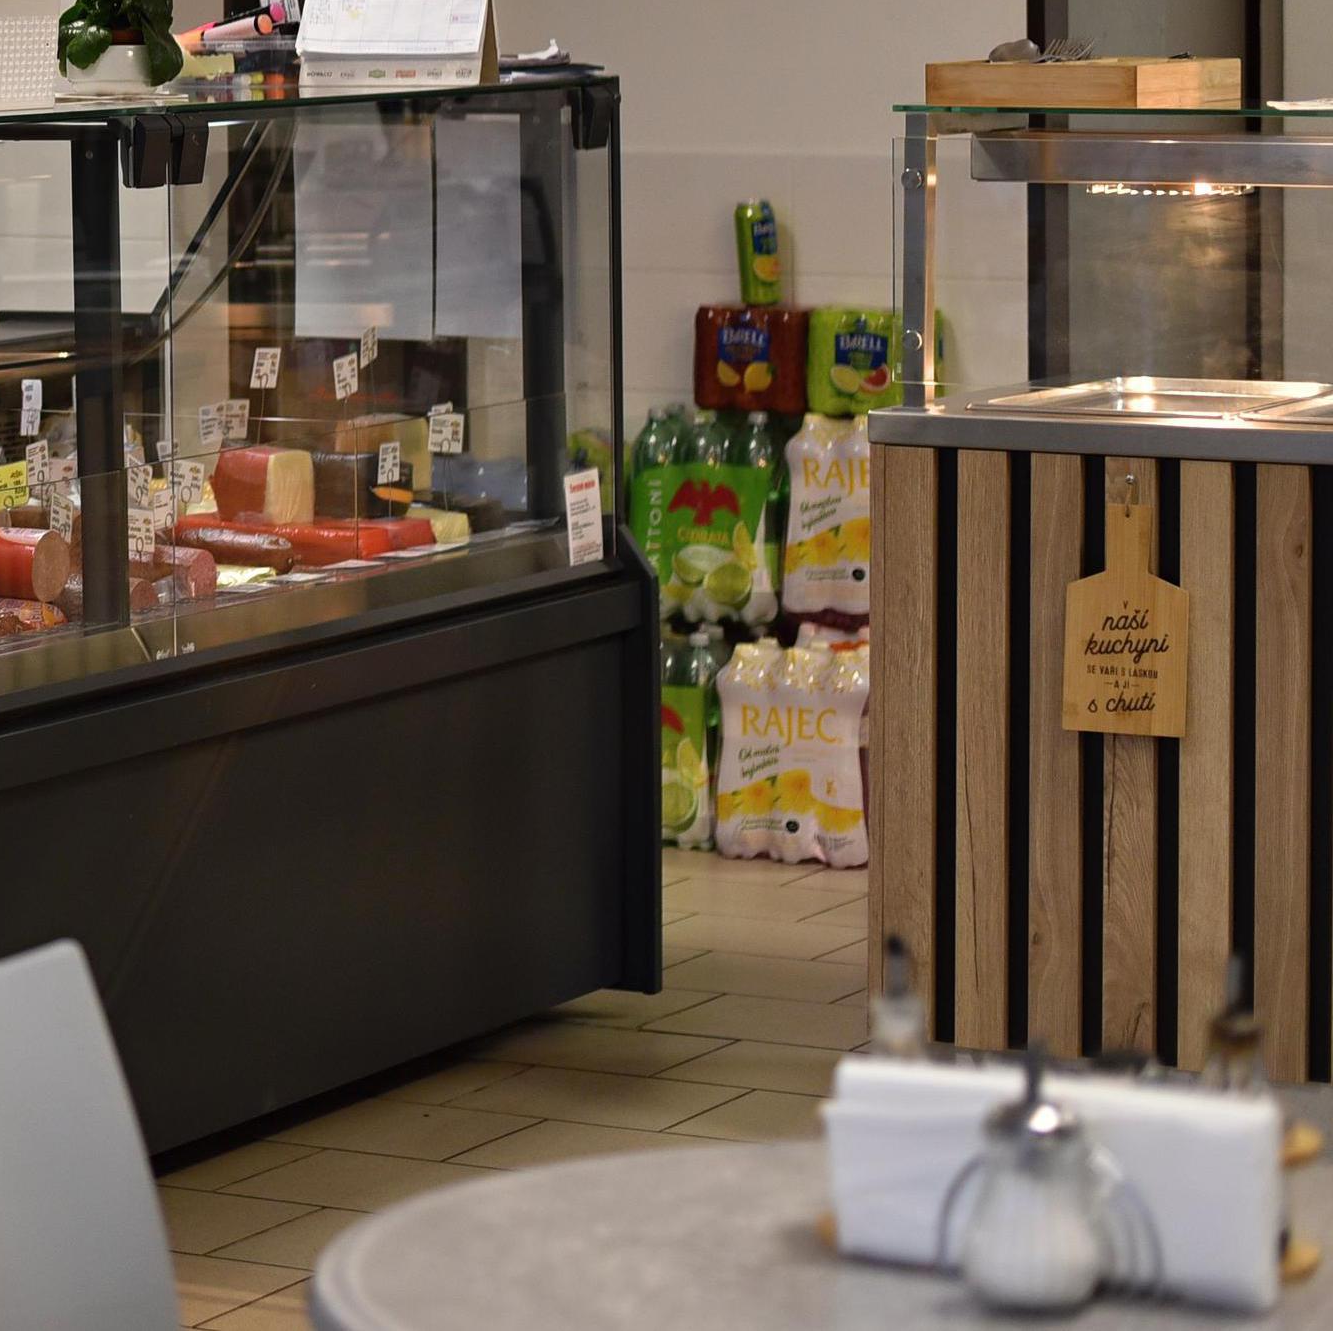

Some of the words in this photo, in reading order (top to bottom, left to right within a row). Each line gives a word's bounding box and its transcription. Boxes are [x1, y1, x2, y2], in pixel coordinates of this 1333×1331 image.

[803, 456, 870, 497] RAJE
[646, 479, 662, 568] ATTONI
[1102, 609, 1150, 631] naší
[1084, 632, 1170, 664] kuchyni
[1087, 698, 1099, 713] s
[740, 703, 839, 747] RAJEC
